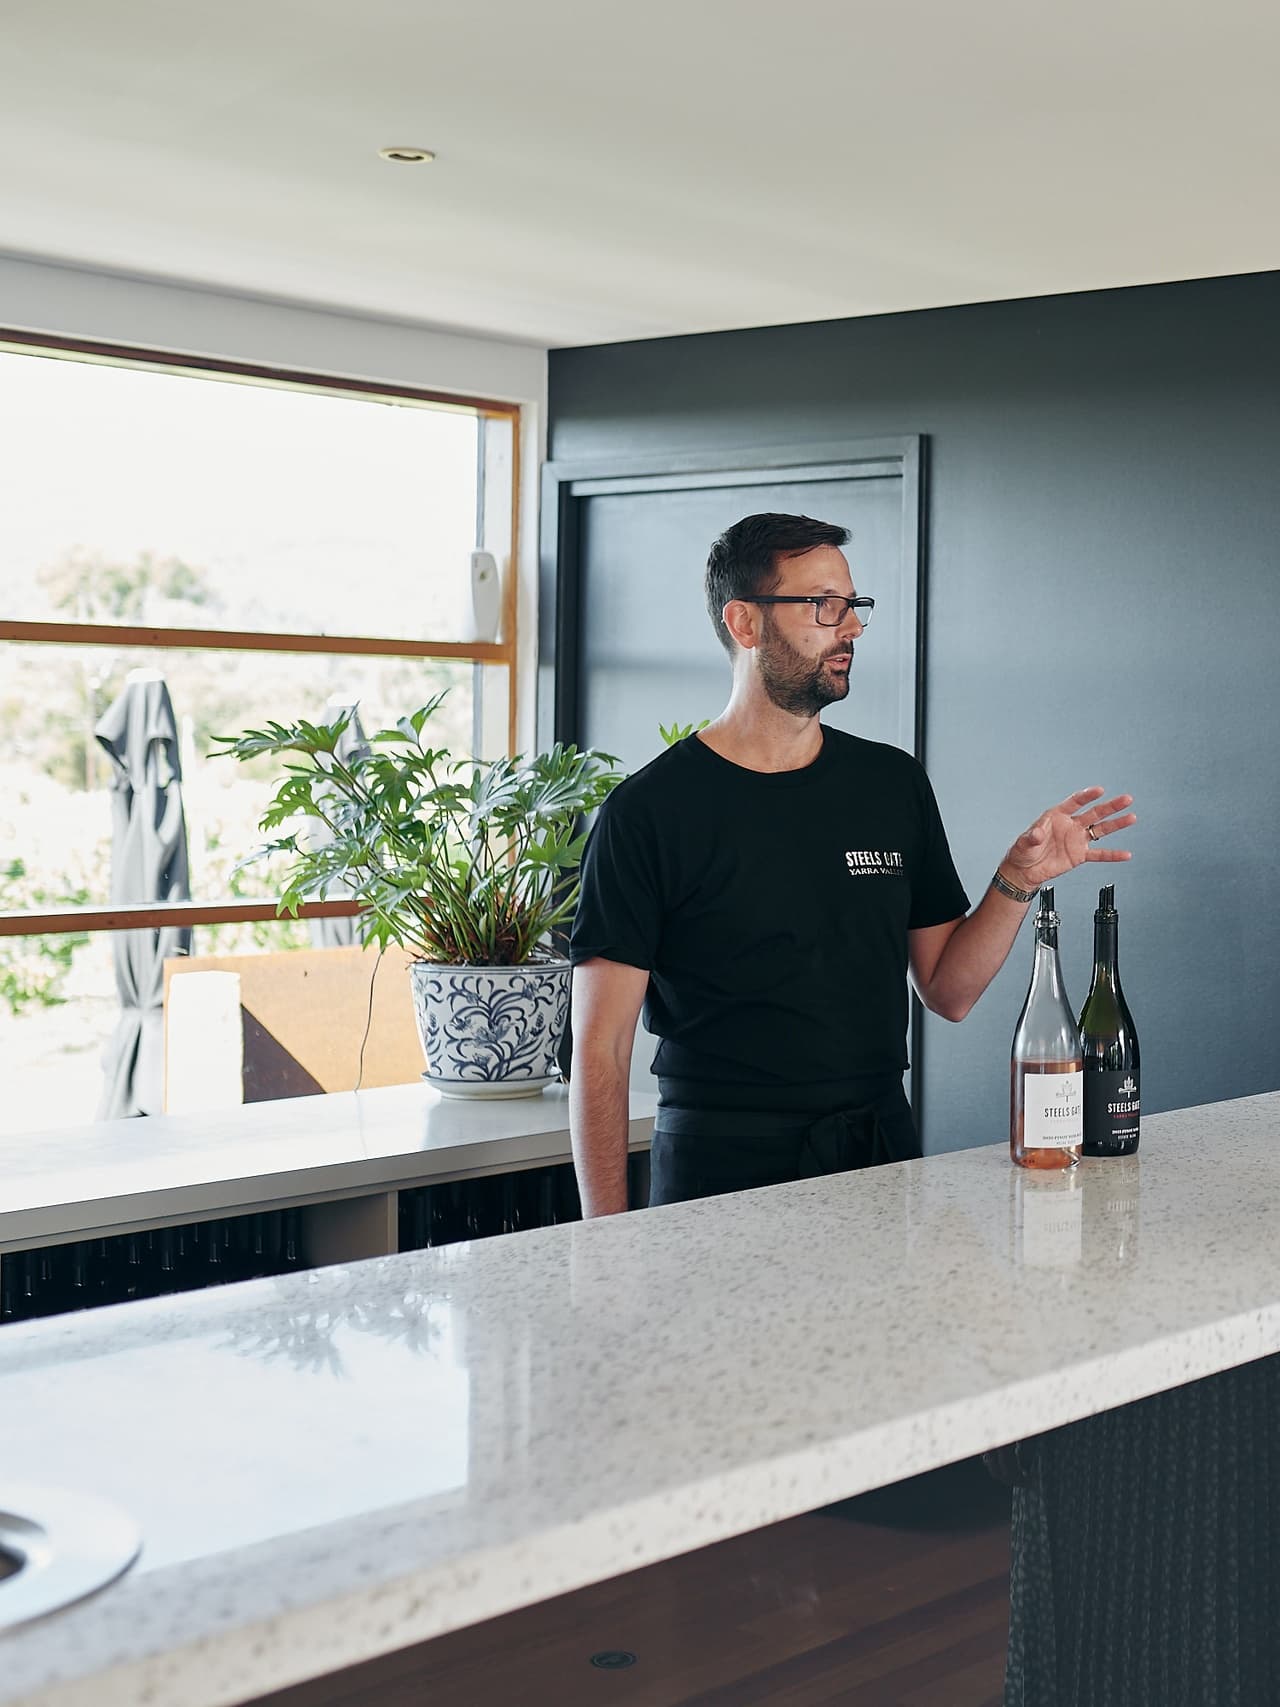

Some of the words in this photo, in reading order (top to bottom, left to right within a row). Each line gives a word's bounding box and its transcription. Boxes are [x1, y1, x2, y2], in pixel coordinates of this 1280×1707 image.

[845, 851, 882, 867] STEELS
[848, 867, 880, 876] YARRA
[1044, 1106, 1070, 1118] STEELS
[1107, 1101, 1131, 1113] STEELS
